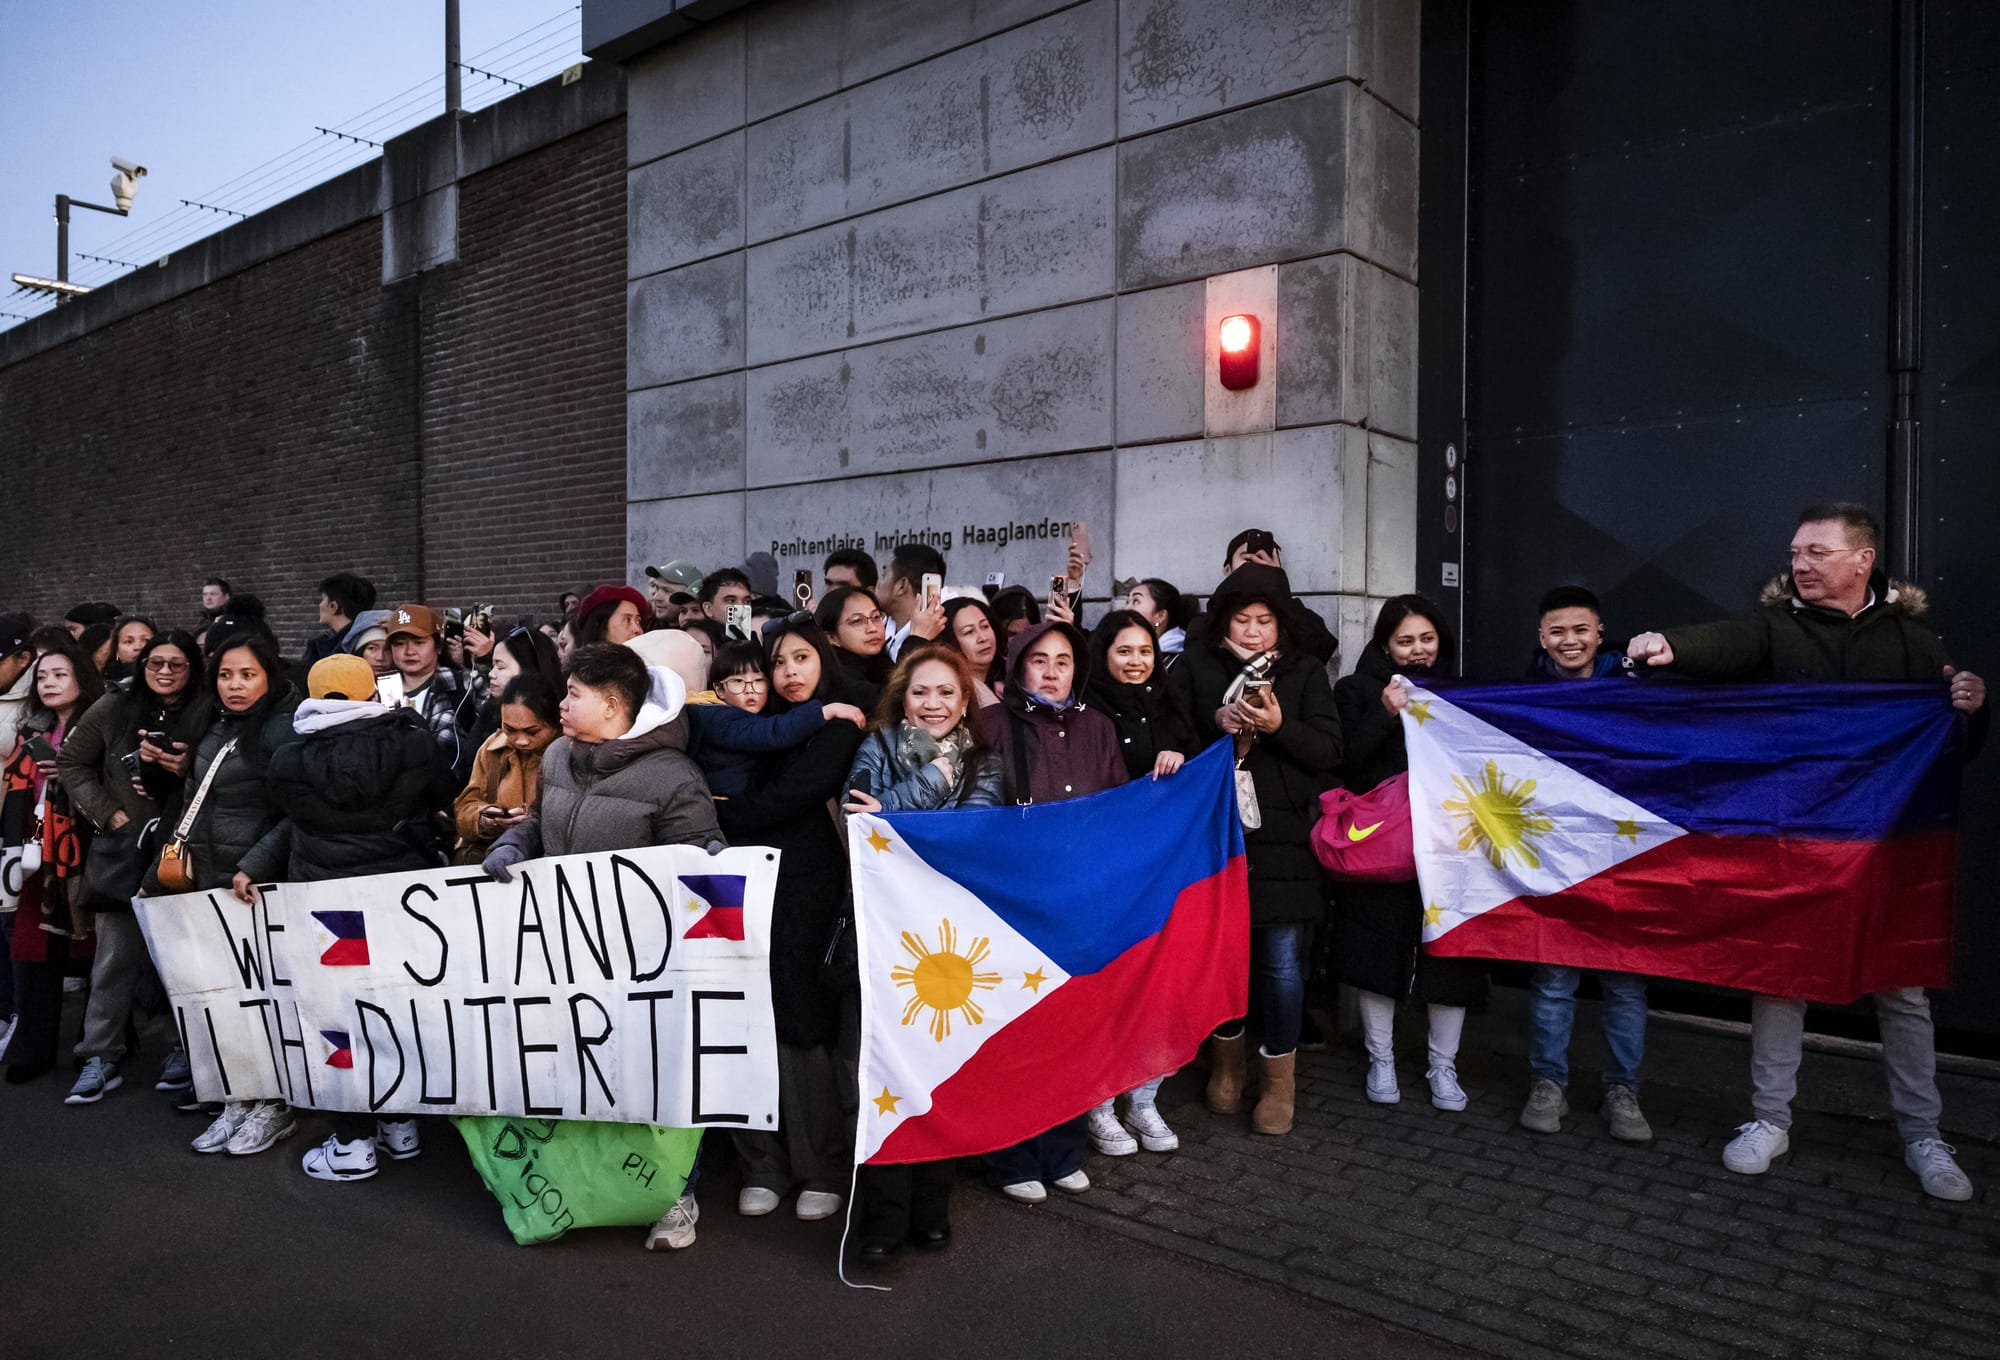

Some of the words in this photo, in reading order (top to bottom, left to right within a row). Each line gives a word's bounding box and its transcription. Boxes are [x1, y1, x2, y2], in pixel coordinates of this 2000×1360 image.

[771, 532, 865, 557] Penitentiaire
[875, 528, 952, 551] Inrichting
[963, 517, 1071, 547] Haaglanden
[398, 610, 411, 625] LA
[208, 884, 292, 991] WE
[400, 855, 673, 987] STAND
[355, 991, 750, 1124] DUTERTE
